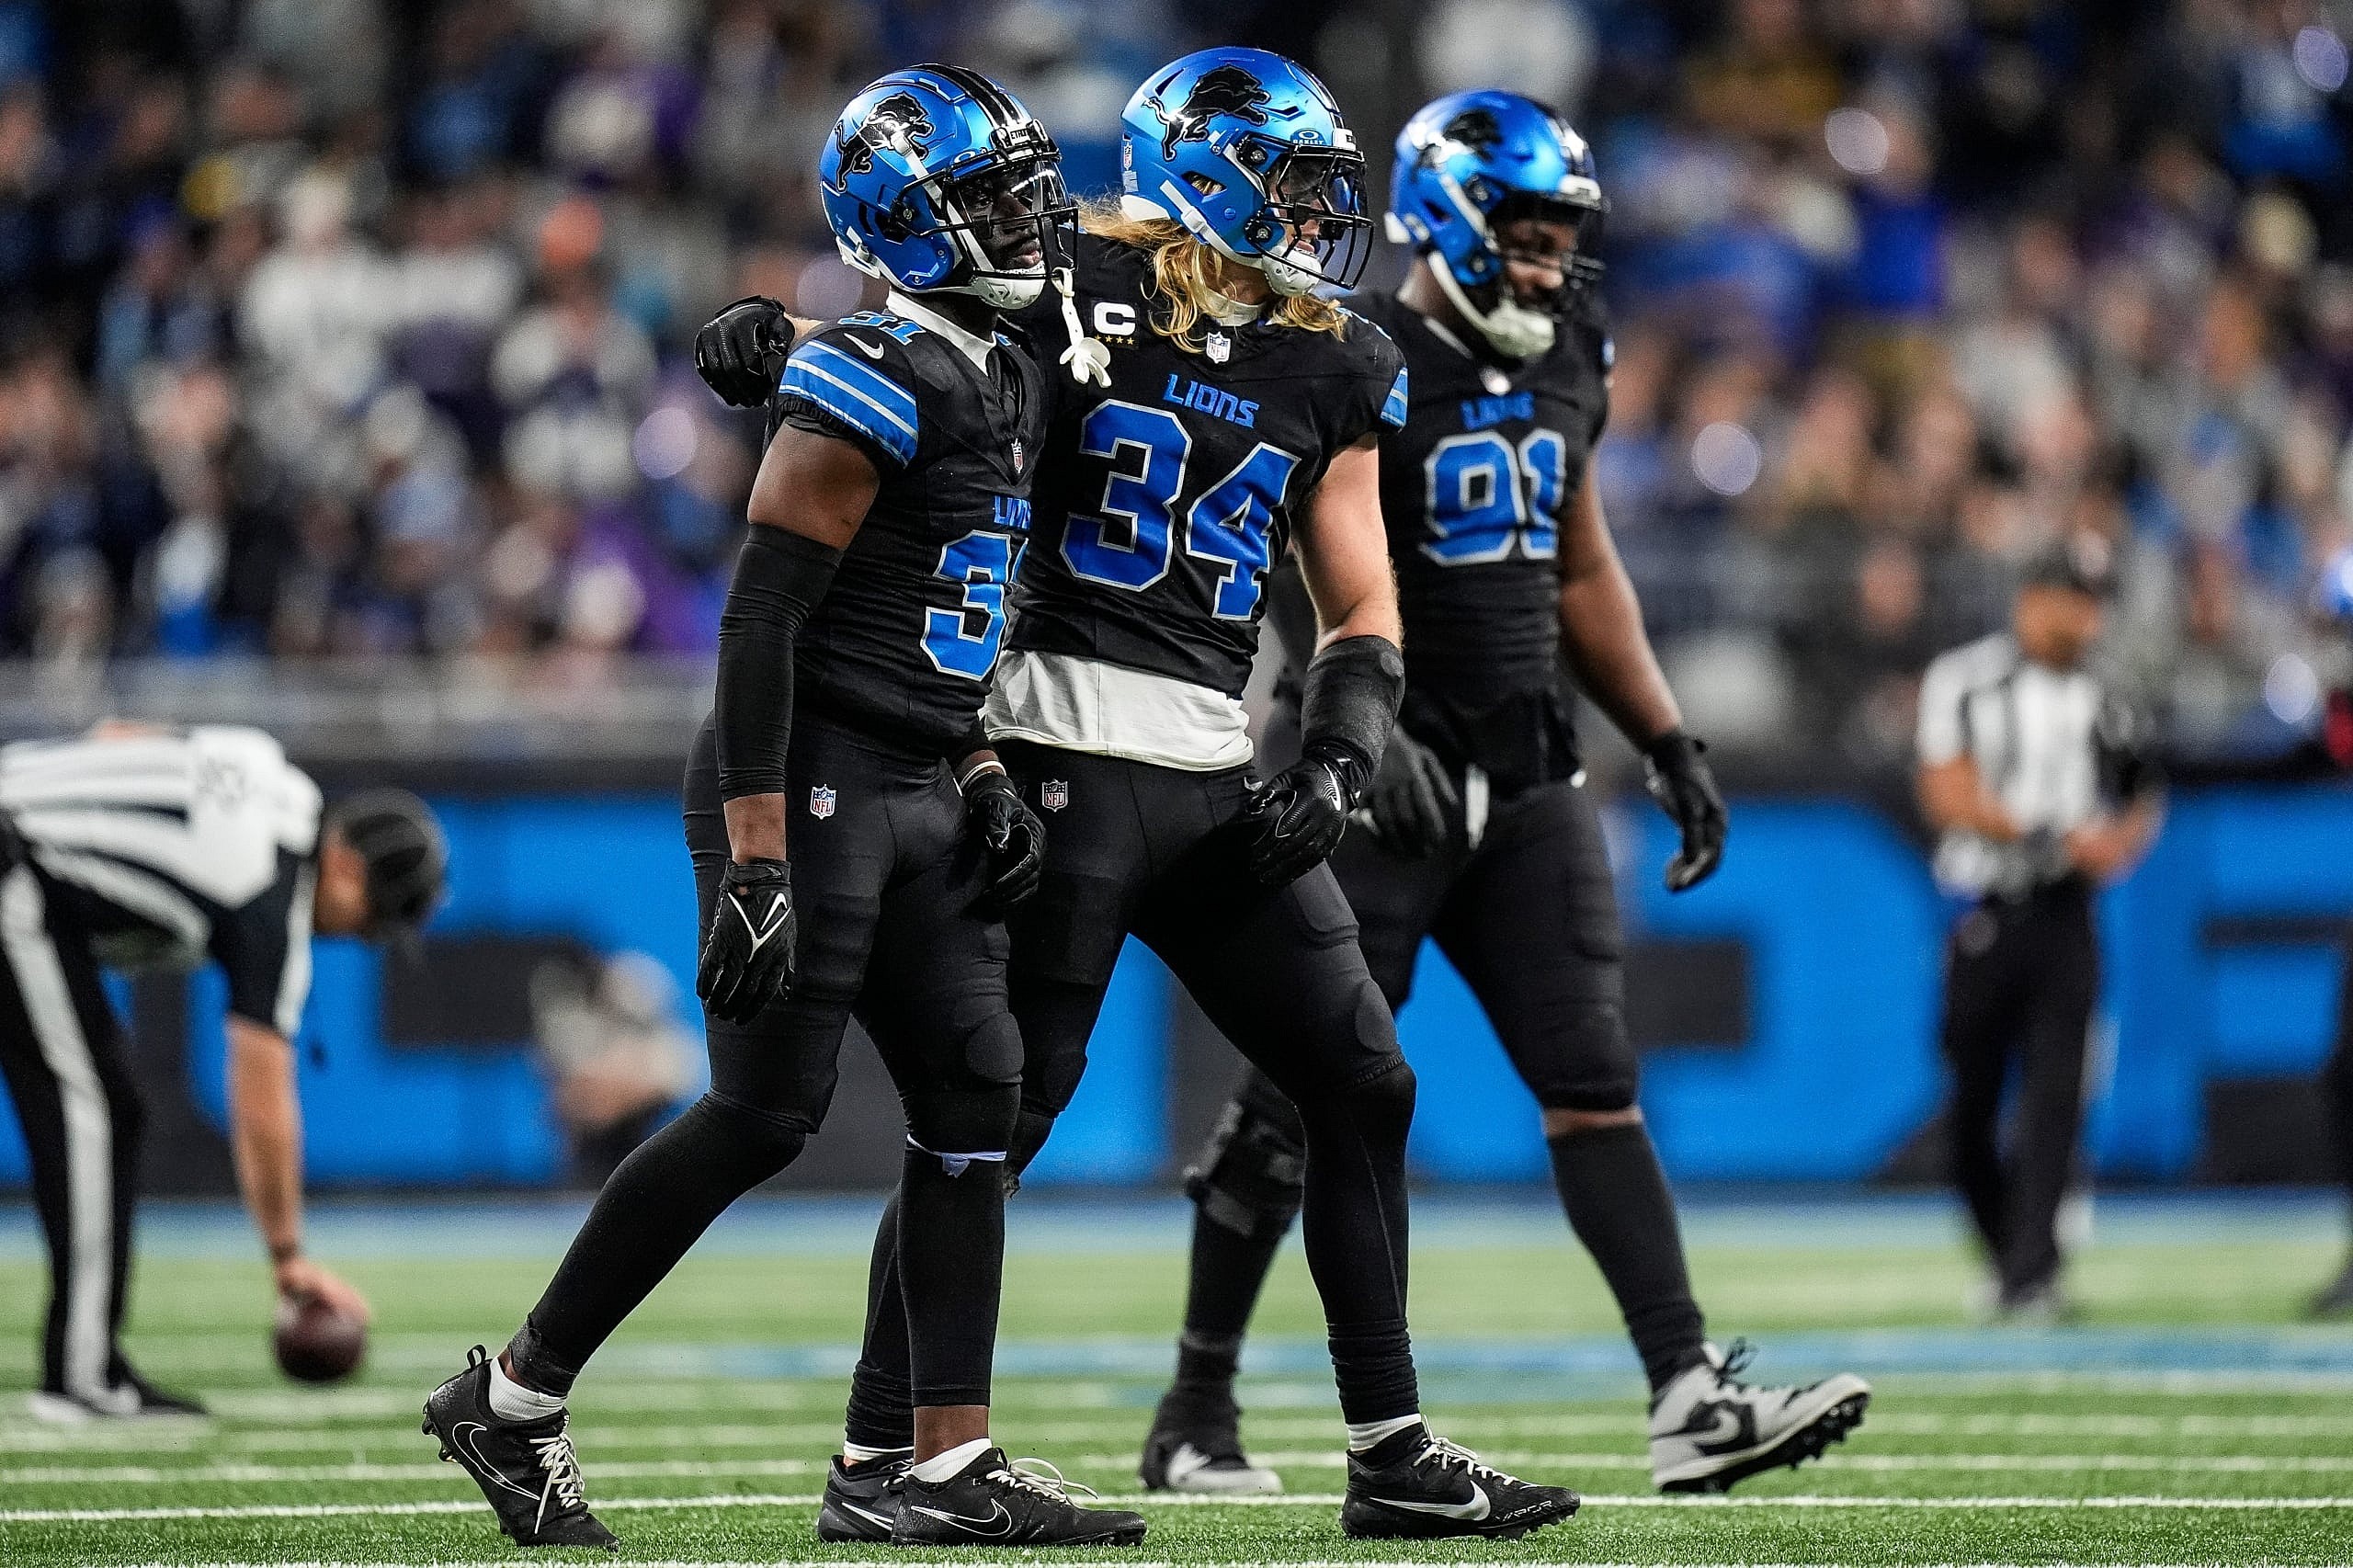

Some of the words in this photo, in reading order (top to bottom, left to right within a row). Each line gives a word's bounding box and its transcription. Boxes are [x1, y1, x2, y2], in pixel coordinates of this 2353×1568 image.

[1094, 301, 1136, 335] C
[1163, 373, 1260, 429] LIONS
[1060, 398, 1302, 620] 34
[1418, 427, 1567, 567] 91
[920, 528, 1029, 682] 3
